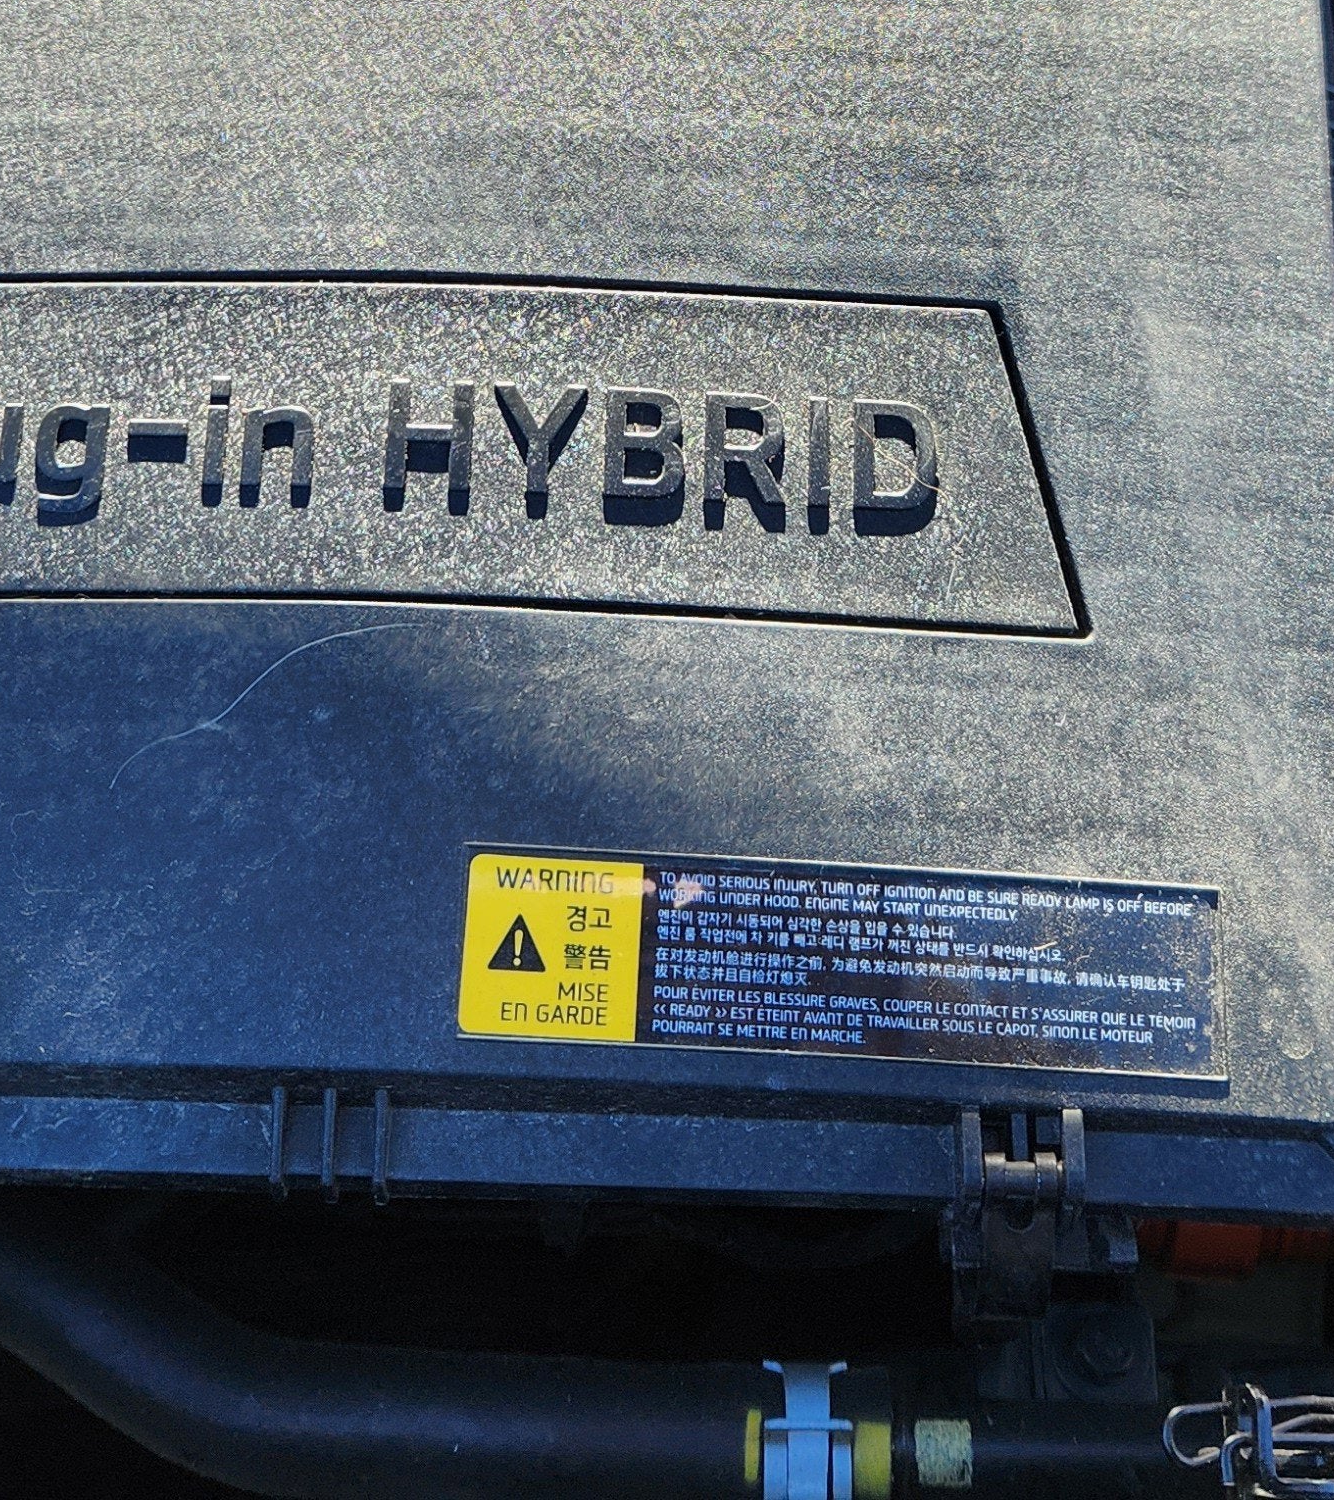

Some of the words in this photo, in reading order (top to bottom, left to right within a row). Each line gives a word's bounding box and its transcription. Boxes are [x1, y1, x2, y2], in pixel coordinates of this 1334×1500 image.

[383, 378, 940, 536] HYBRID
[660, 872, 676, 885] TO
[681, 872, 715, 887] AVOID
[719, 876, 770, 890] SERIOUS
[821, 881, 854, 895] TURN
[857, 883, 881, 896] OFF
[884, 885, 936, 899] IGNITION
[939, 889, 965, 902] AND
[968, 890, 984, 903] BE
[987, 891, 1019, 906] SURE
[1022, 893, 1061, 908] READY
[1066, 896, 1100, 909] LAMP
[1103, 898, 1115, 911] IS
[1117, 899, 1141, 913] OFF
[1144, 901, 1193, 916] BEFORE
[719, 892, 761, 906] UNDER
[764, 895, 801, 908] HOOD.
[806, 897, 849, 912] ENGINE
[853, 900, 880, 914] MAY
[883, 902, 921, 915] START
[566, 905, 613, 933] 경고
[658, 909, 693, 925] 엔진이
[697, 911, 732, 927] 갑자기
[737, 914, 783, 930] 시동되어
[787, 917, 822, 932] 심각한
[826, 919, 861, 935] 손상을
[865, 920, 888, 937] 입을
[892, 923, 905, 937] 수
[907, 924, 958, 940] 있습니다.
[657, 925, 680, 942] 엔진
[700, 928, 747, 944] 작업전에
[750, 931, 763, 944] 차
[767, 932, 790, 947] 키를
[822, 935, 844, 951] 레디
[849, 937, 883, 952] 램프가
[887, 939, 911, 954] 꺼진
[914, 941, 949, 956] 상태를
[953, 944, 989, 959] 반드시
[563, 943, 612, 971] 警告
[557, 982, 609, 1003] MISE
[653, 985, 688, 999] POUR
[738, 991, 761, 1003] LES
[764, 992, 826, 1008] BLESSURE
[830, 996, 880, 1013] GRAVES,
[883, 999, 932, 1013] COUPER
[936, 1002, 950, 1015] LE
[954, 1003, 1009, 1018] CONTACT
[1012, 1007, 1027, 1020] ET
[1031, 1007, 1098, 1024] S'ASSURER
[1102, 1012, 1127, 1026] QUE
[1130, 1013, 1145, 1027] LE
[500, 1001, 528, 1022] EN
[536, 1004, 608, 1026] GARDE
[669, 1003, 711, 1018] READY
[730, 1008, 754, 1021] EST
[803, 1012, 843, 1026] AVANT
[847, 1014, 863, 1026] DE
[867, 1015, 939, 1031] TRAVAILLER
[942, 1020, 975, 1033] SOUS
[978, 1022, 993, 1034] LE
[1082, 1028, 1097, 1040] LE
[1101, 1029, 1153, 1043] MOTEUR
[652, 1019, 714, 1035] POURRAIT
[718, 1023, 733, 1036] SE
[736, 1024, 787, 1039] METTRE
[791, 1027, 807, 1040] EN
[811, 1030, 866, 1044] MARCHE.
